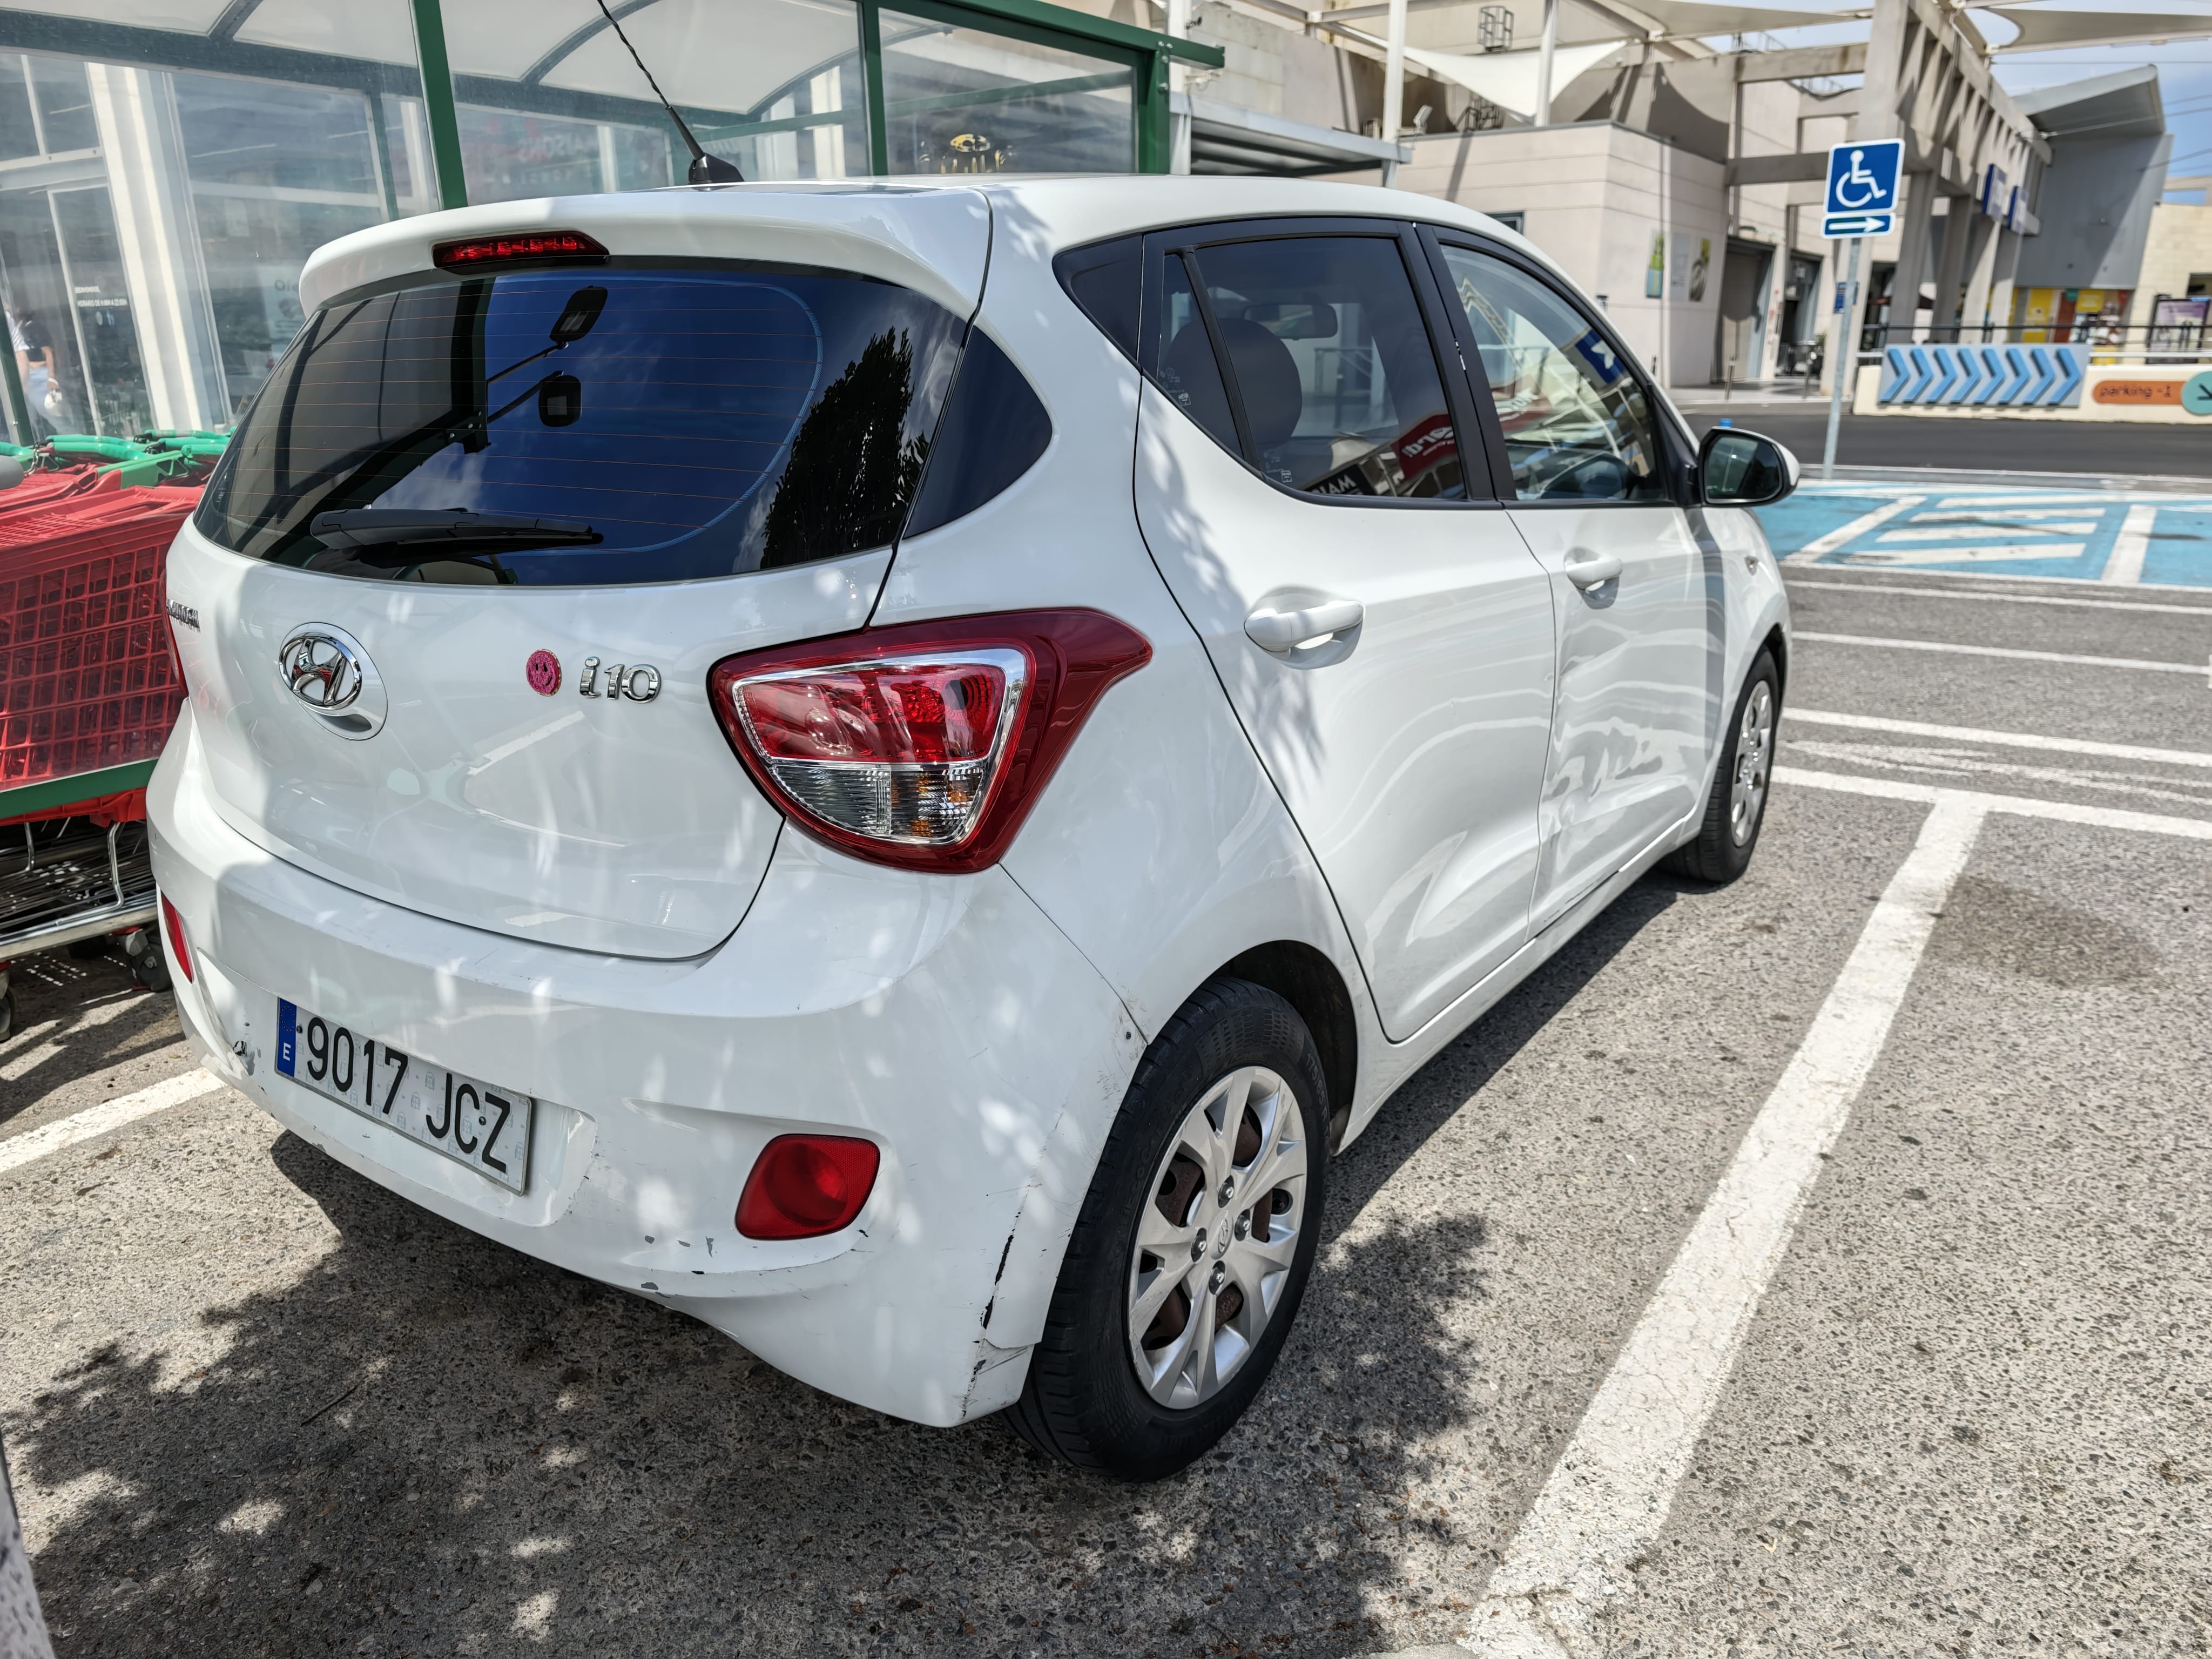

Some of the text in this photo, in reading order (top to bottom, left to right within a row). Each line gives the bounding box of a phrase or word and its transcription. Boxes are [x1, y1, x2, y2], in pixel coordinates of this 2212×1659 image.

[2100, 384, 2153, 400] parking
[579, 656, 662, 703] i10
[282, 1042, 291, 1061] E
[307, 1017, 511, 1174] 9017 JCZ
